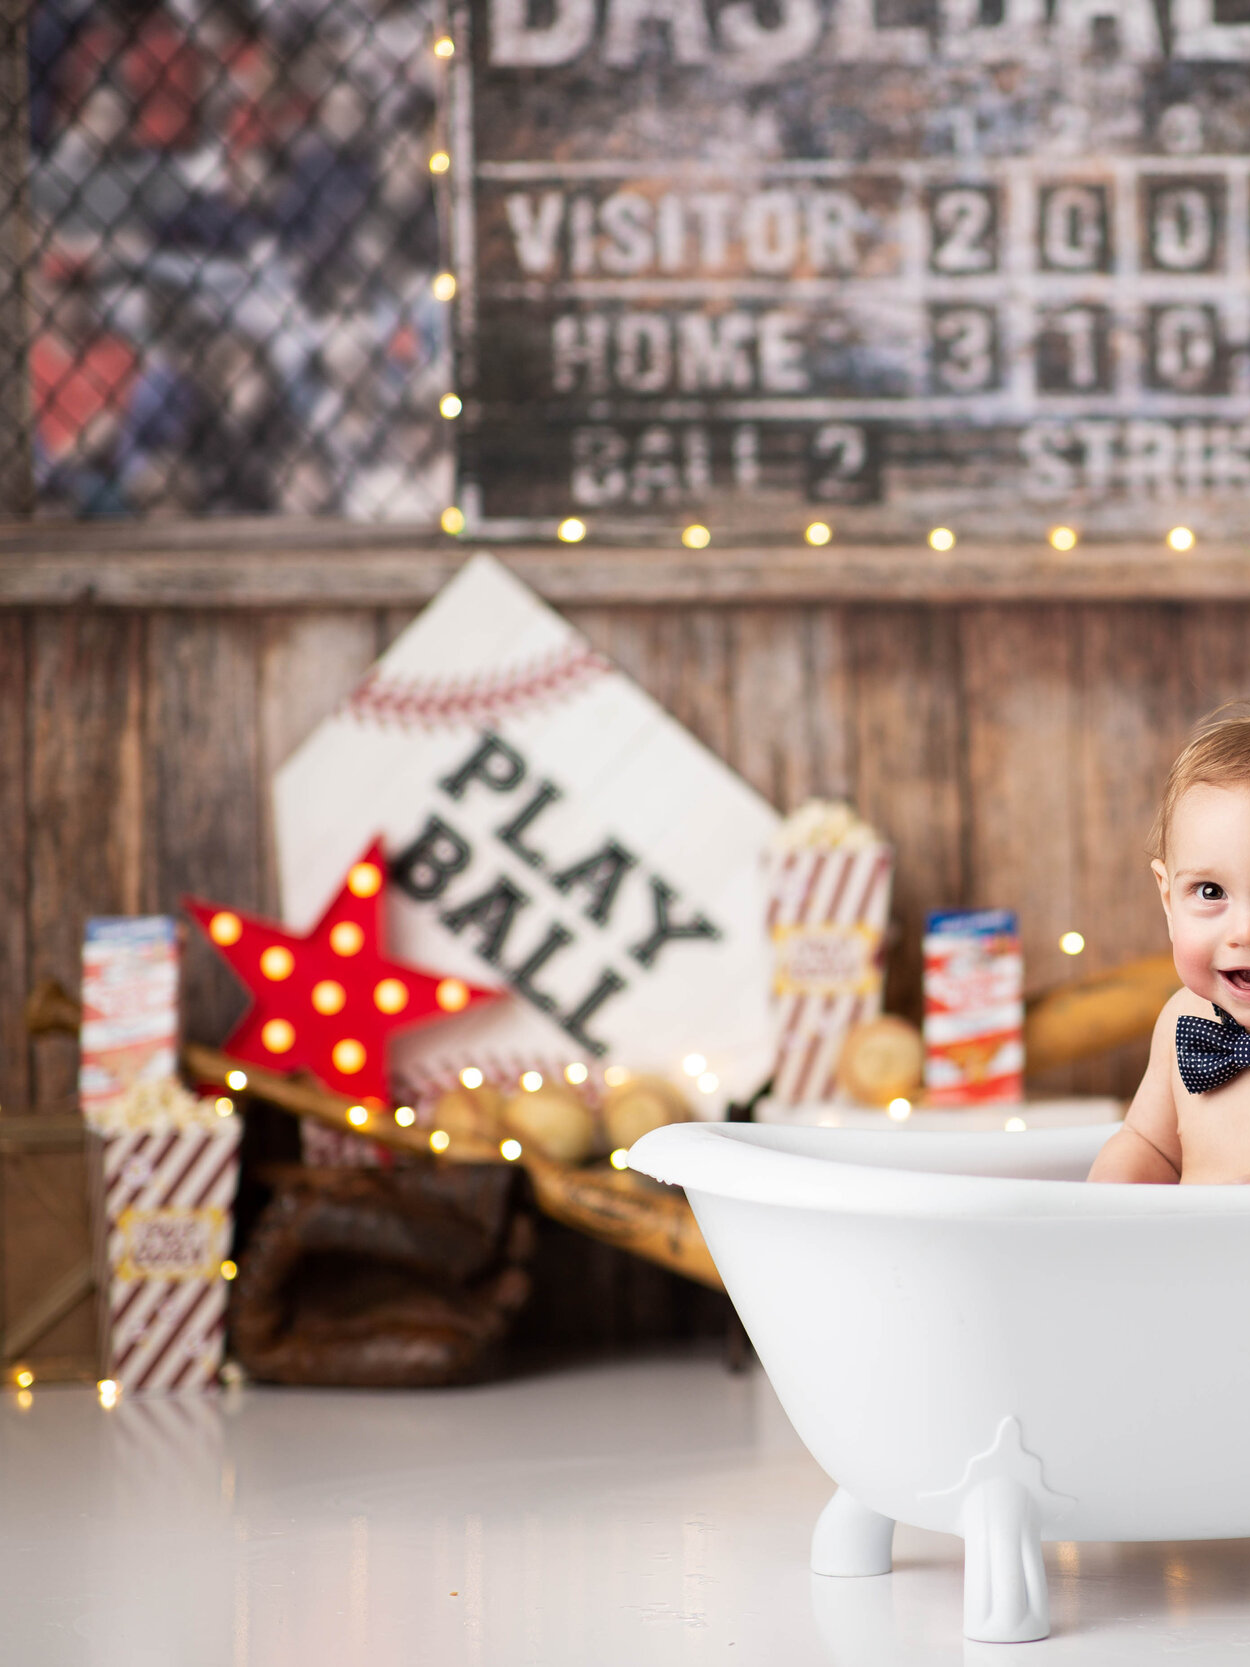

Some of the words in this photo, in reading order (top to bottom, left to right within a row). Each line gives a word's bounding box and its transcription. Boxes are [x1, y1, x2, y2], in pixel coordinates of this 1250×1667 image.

[506, 191, 862, 275] VISITOR
[932, 187, 995, 274] 2
[1043, 187, 1103, 273] 0
[1153, 187, 1212, 271] 0
[552, 312, 808, 394] HOME
[934, 308, 994, 391] 3
[1056, 310, 1097, 388] 1
[1155, 308, 1214, 390] 0
[812, 423, 868, 500] 2
[438, 729, 723, 970] PLAY
[389, 813, 627, 1058] BALL
